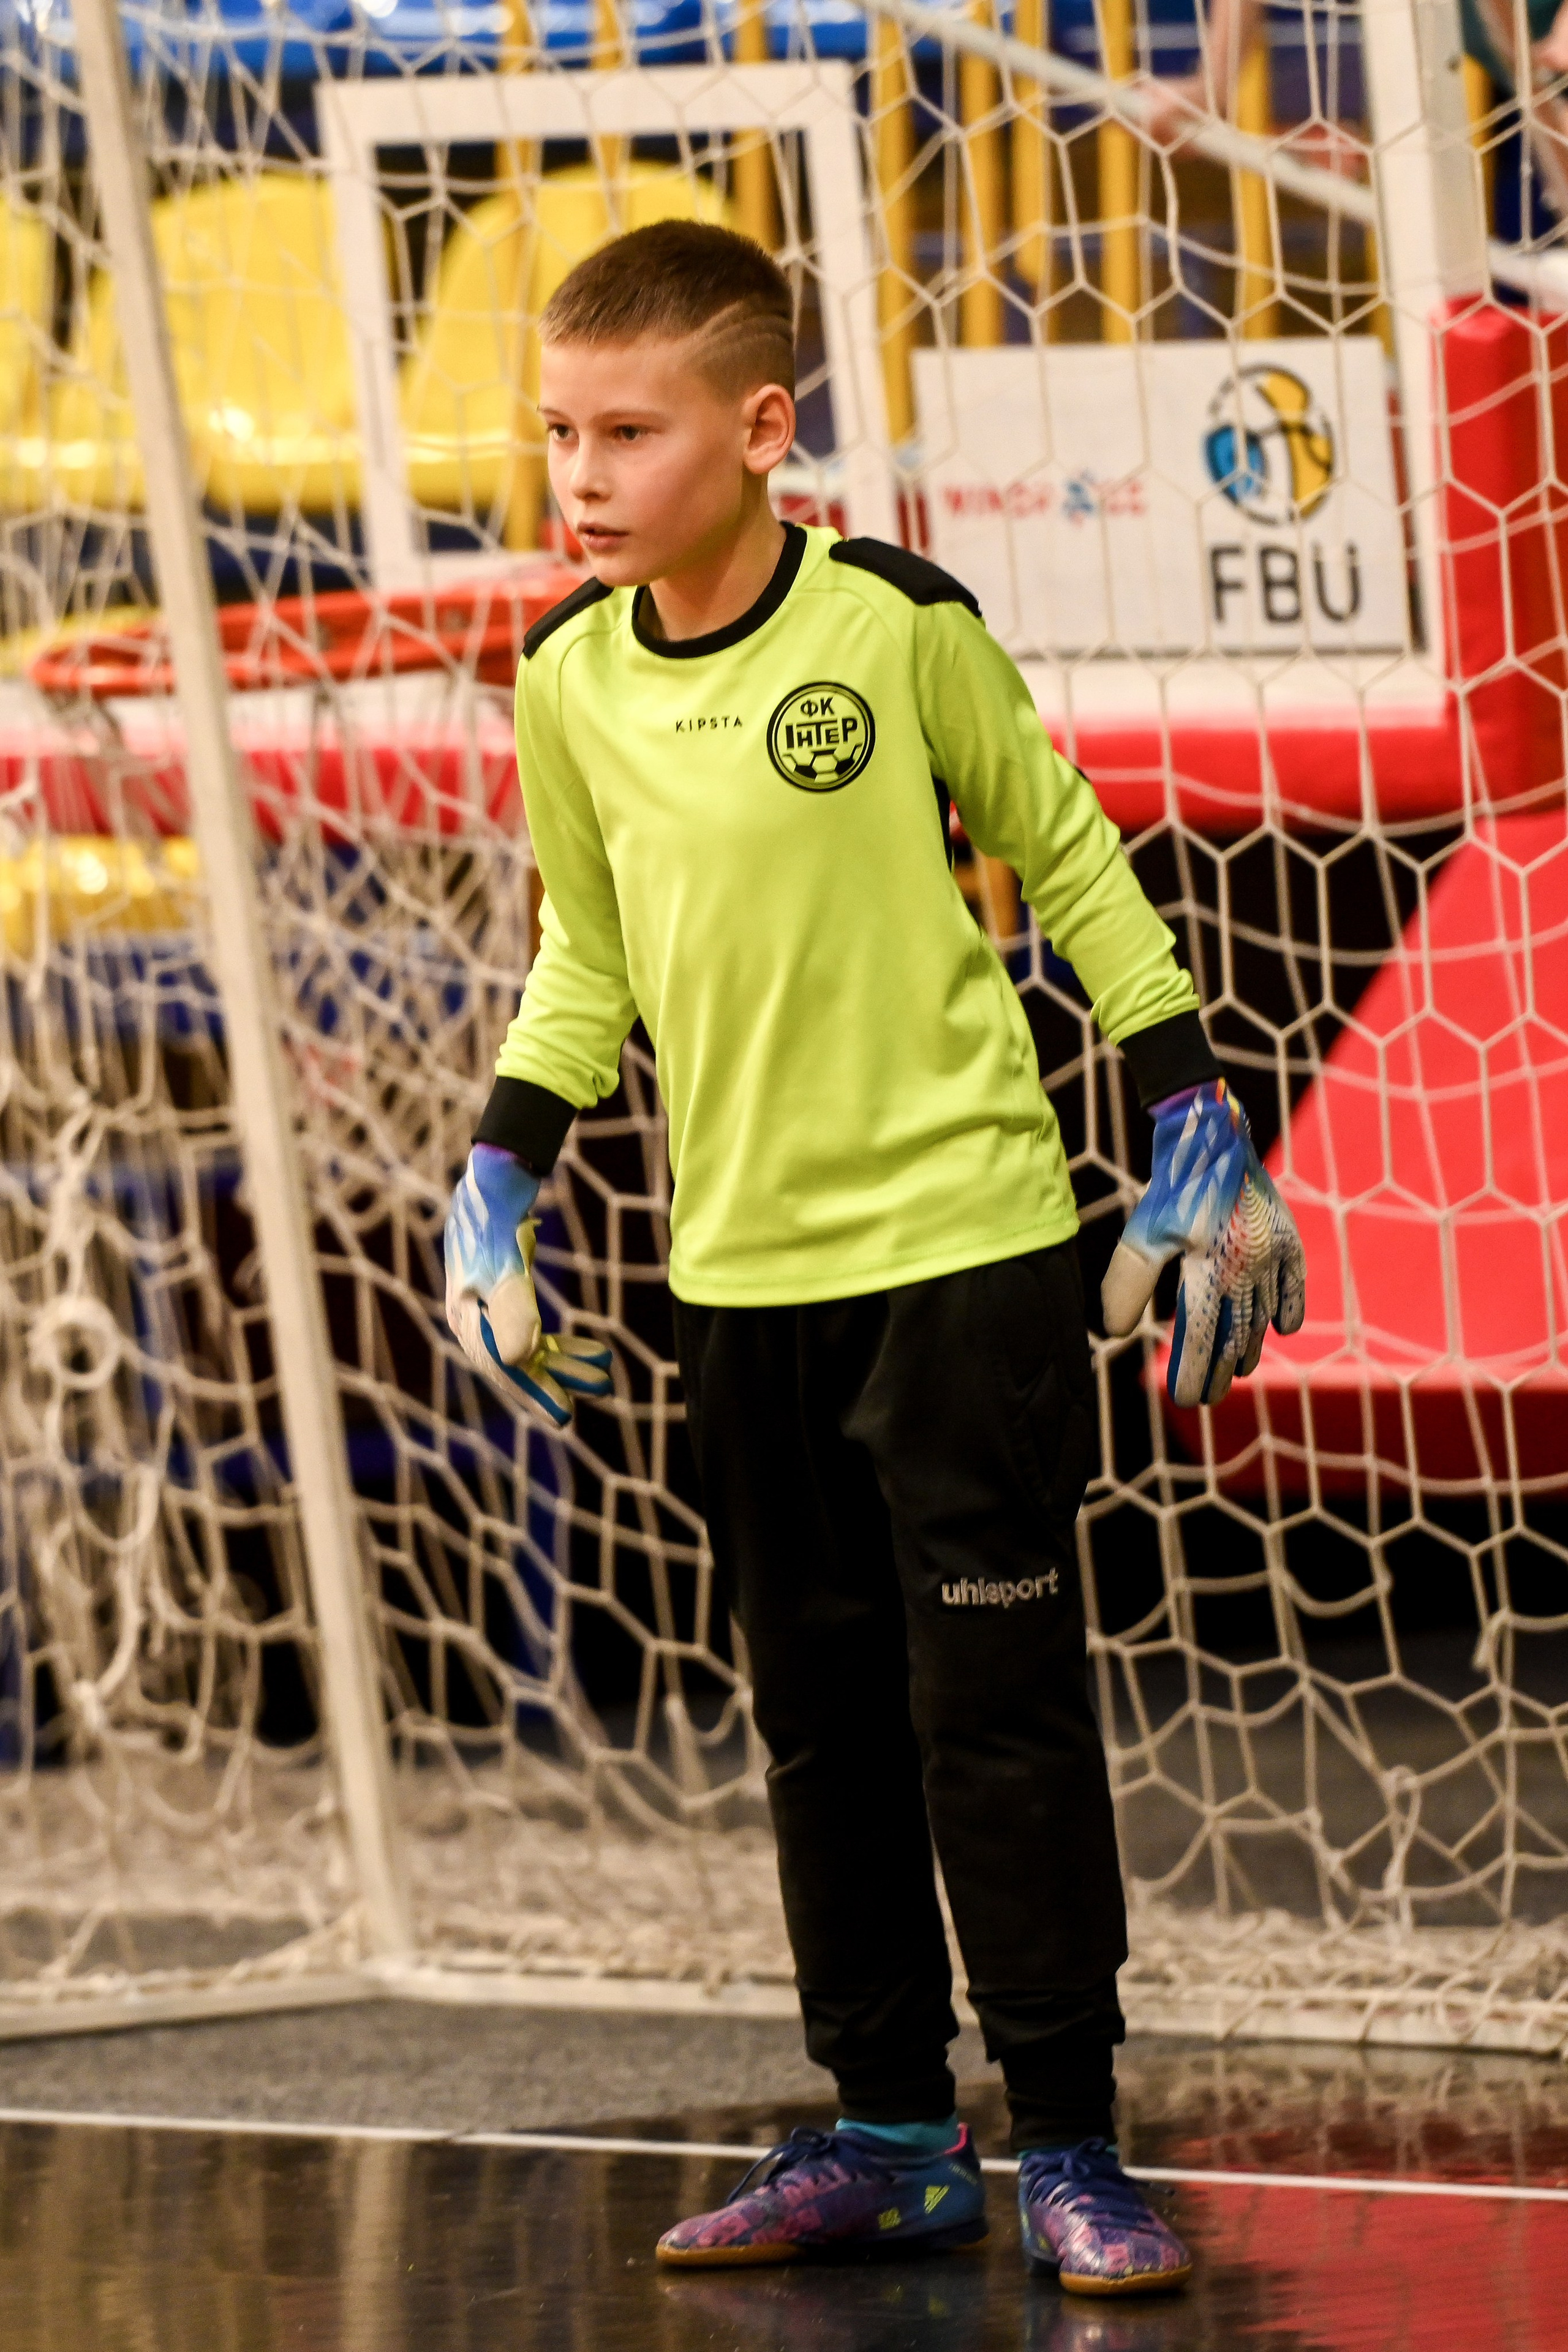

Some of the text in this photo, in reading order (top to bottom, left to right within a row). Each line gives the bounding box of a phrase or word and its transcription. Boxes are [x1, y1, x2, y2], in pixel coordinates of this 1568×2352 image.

[1209, 541, 1360, 624] FBU
[801, 697, 834, 717] ФК
[676, 715, 742, 733] KIPSTA
[942, 1567, 1058, 1608] uhlsport
